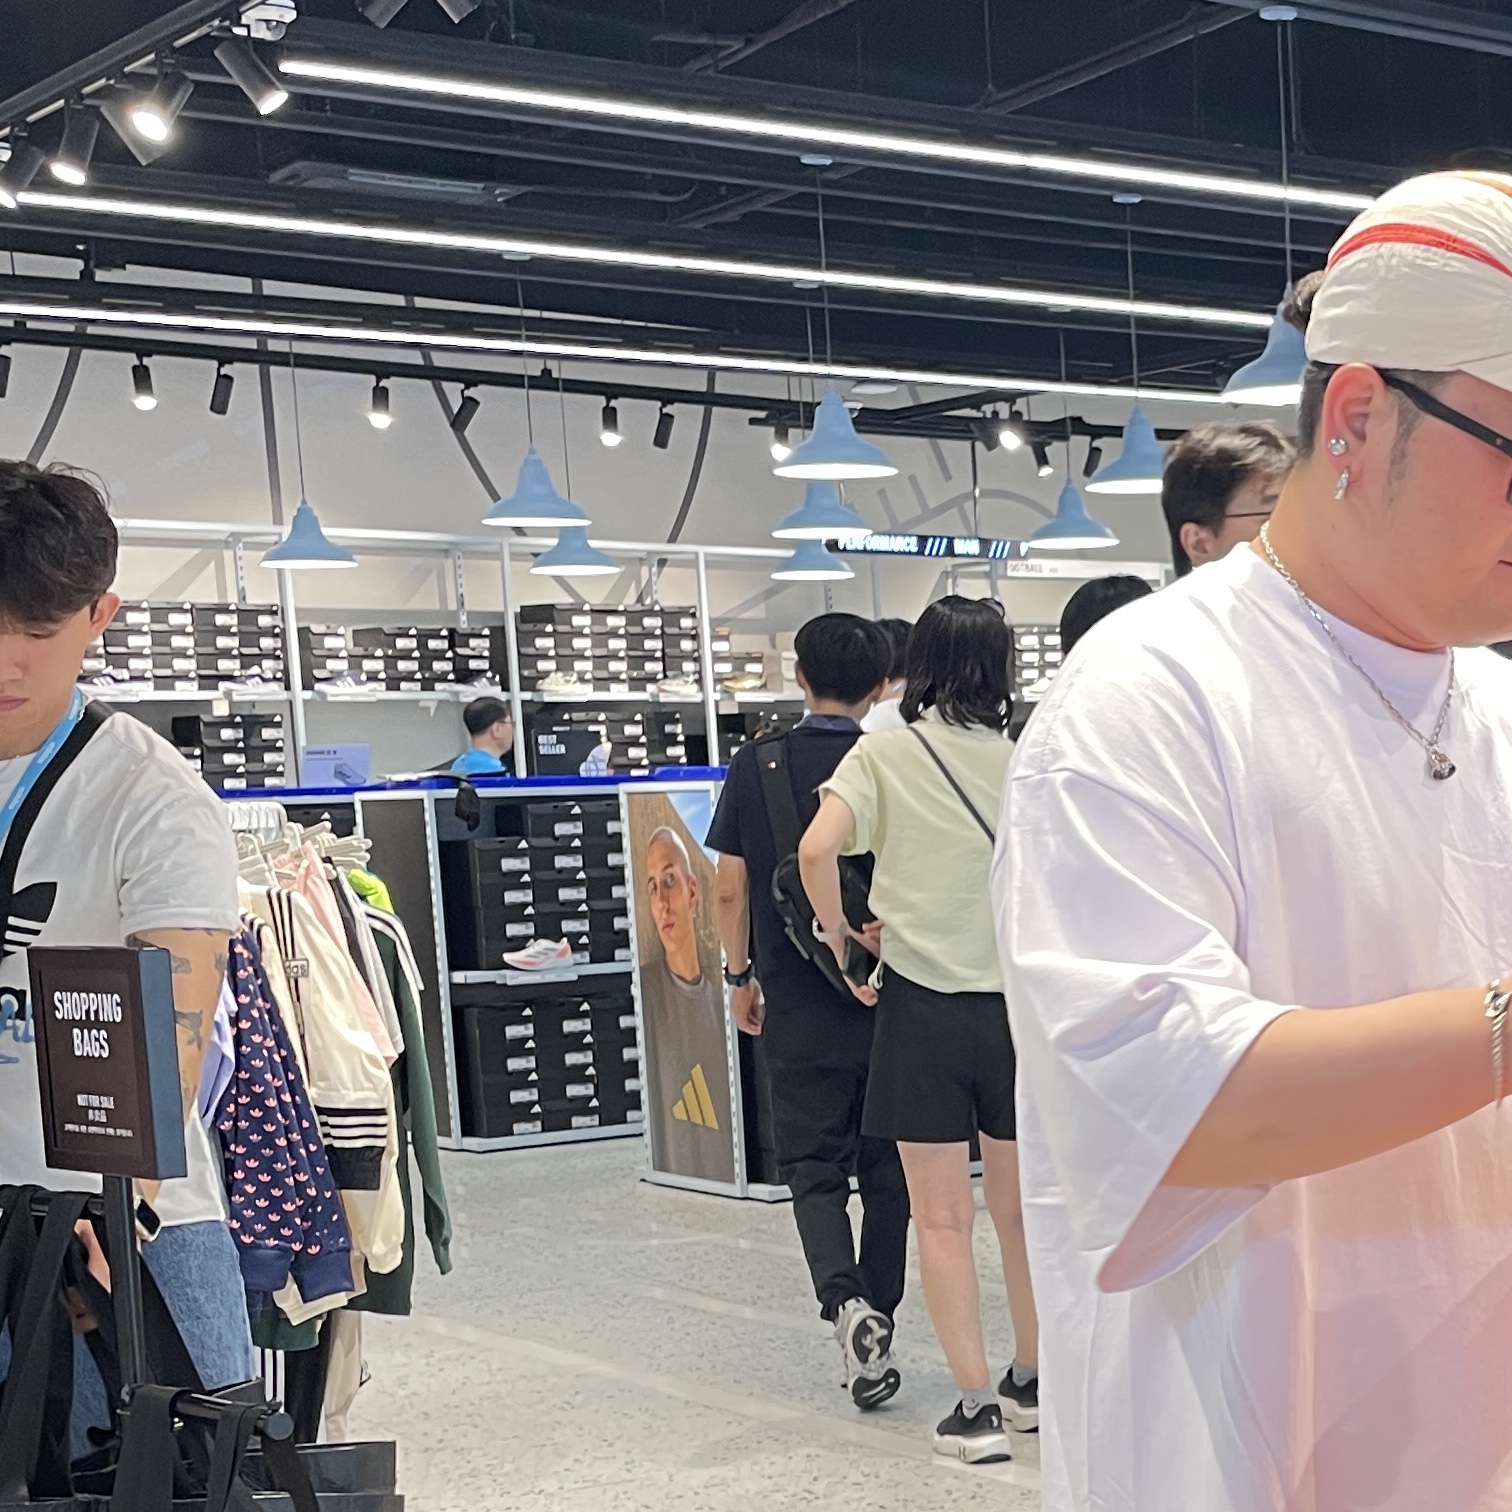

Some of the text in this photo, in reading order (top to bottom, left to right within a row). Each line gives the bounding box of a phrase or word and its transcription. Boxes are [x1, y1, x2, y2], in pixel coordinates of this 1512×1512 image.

[838, 535, 918, 553] PERFORMANCE
[537, 734, 557, 744] BEST
[539, 744, 567, 755] SELLER
[53, 990, 123, 1023] SHOPPING
[72, 1028, 110, 1059] BAGS
[100, 1095, 115, 1109] SALE
